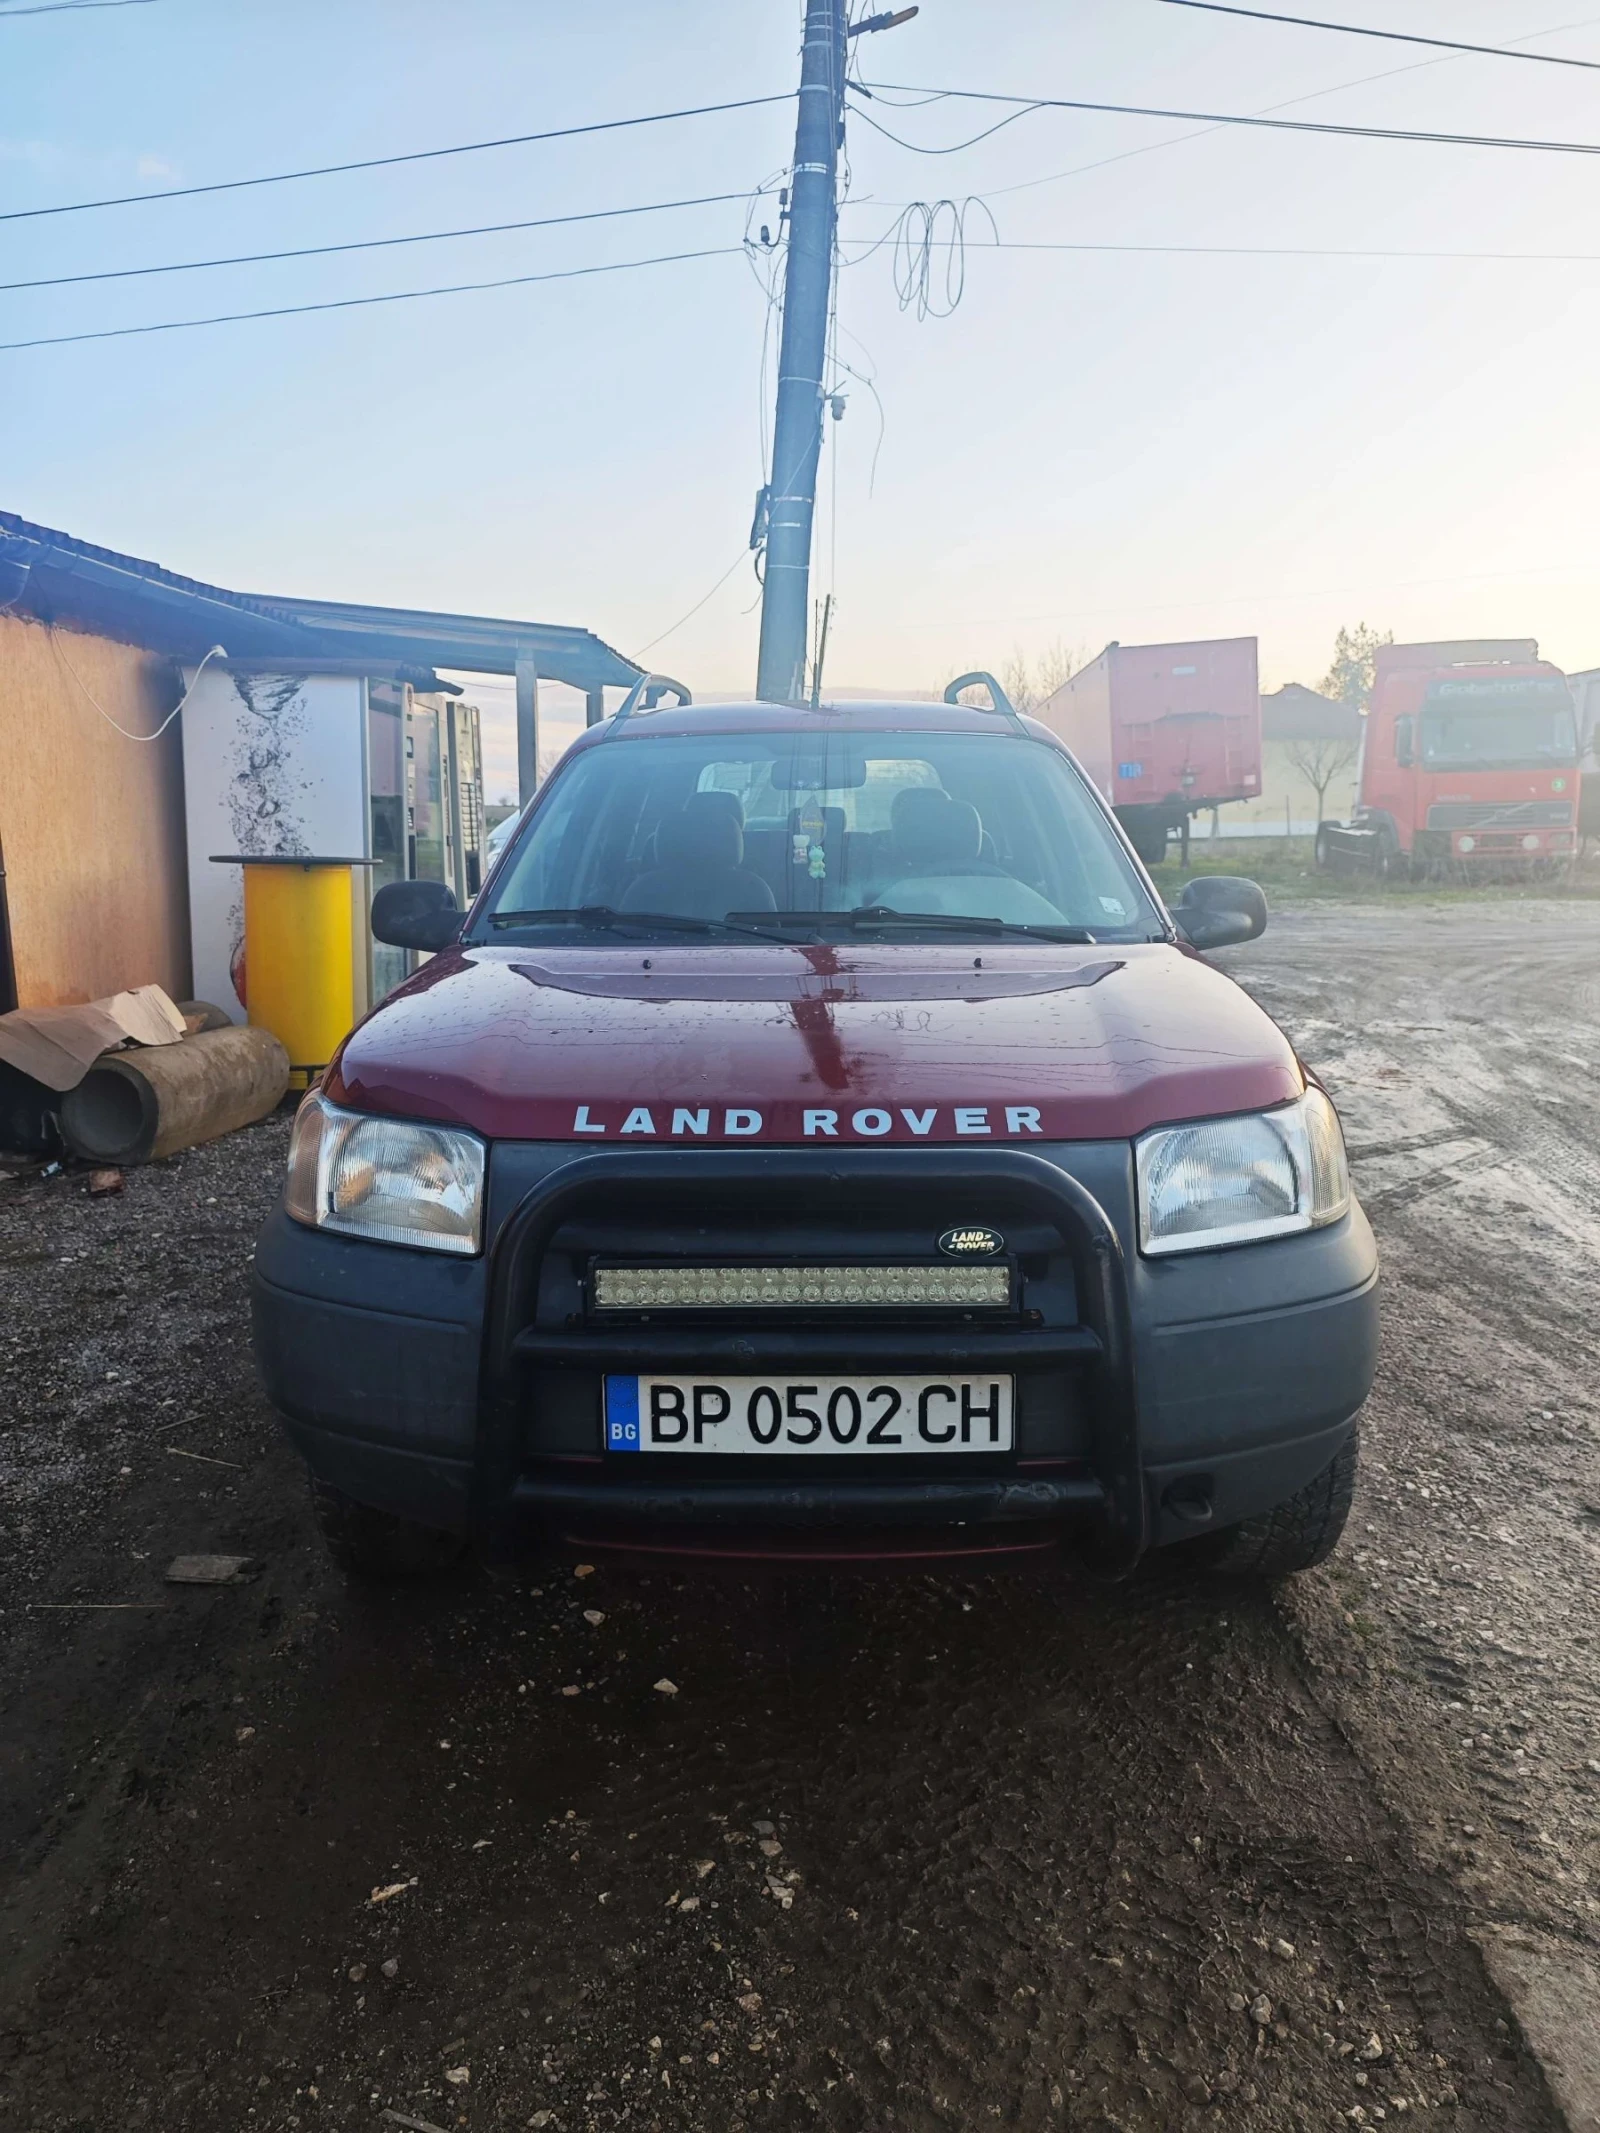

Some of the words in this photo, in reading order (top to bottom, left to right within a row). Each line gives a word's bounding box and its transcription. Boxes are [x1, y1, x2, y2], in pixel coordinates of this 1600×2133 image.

[1120, 763, 1142, 778] TIR
[573, 1106, 763, 1136] LAND
[803, 1106, 1044, 1136] ROVER
[951, 1231, 984, 1242] LAND
[955, 1241, 995, 1251] ROVER
[650, 1385, 731, 1443] BP
[747, 1385, 902, 1444] 0502
[918, 1383, 1000, 1443] CH
[611, 1423, 637, 1440] BG
